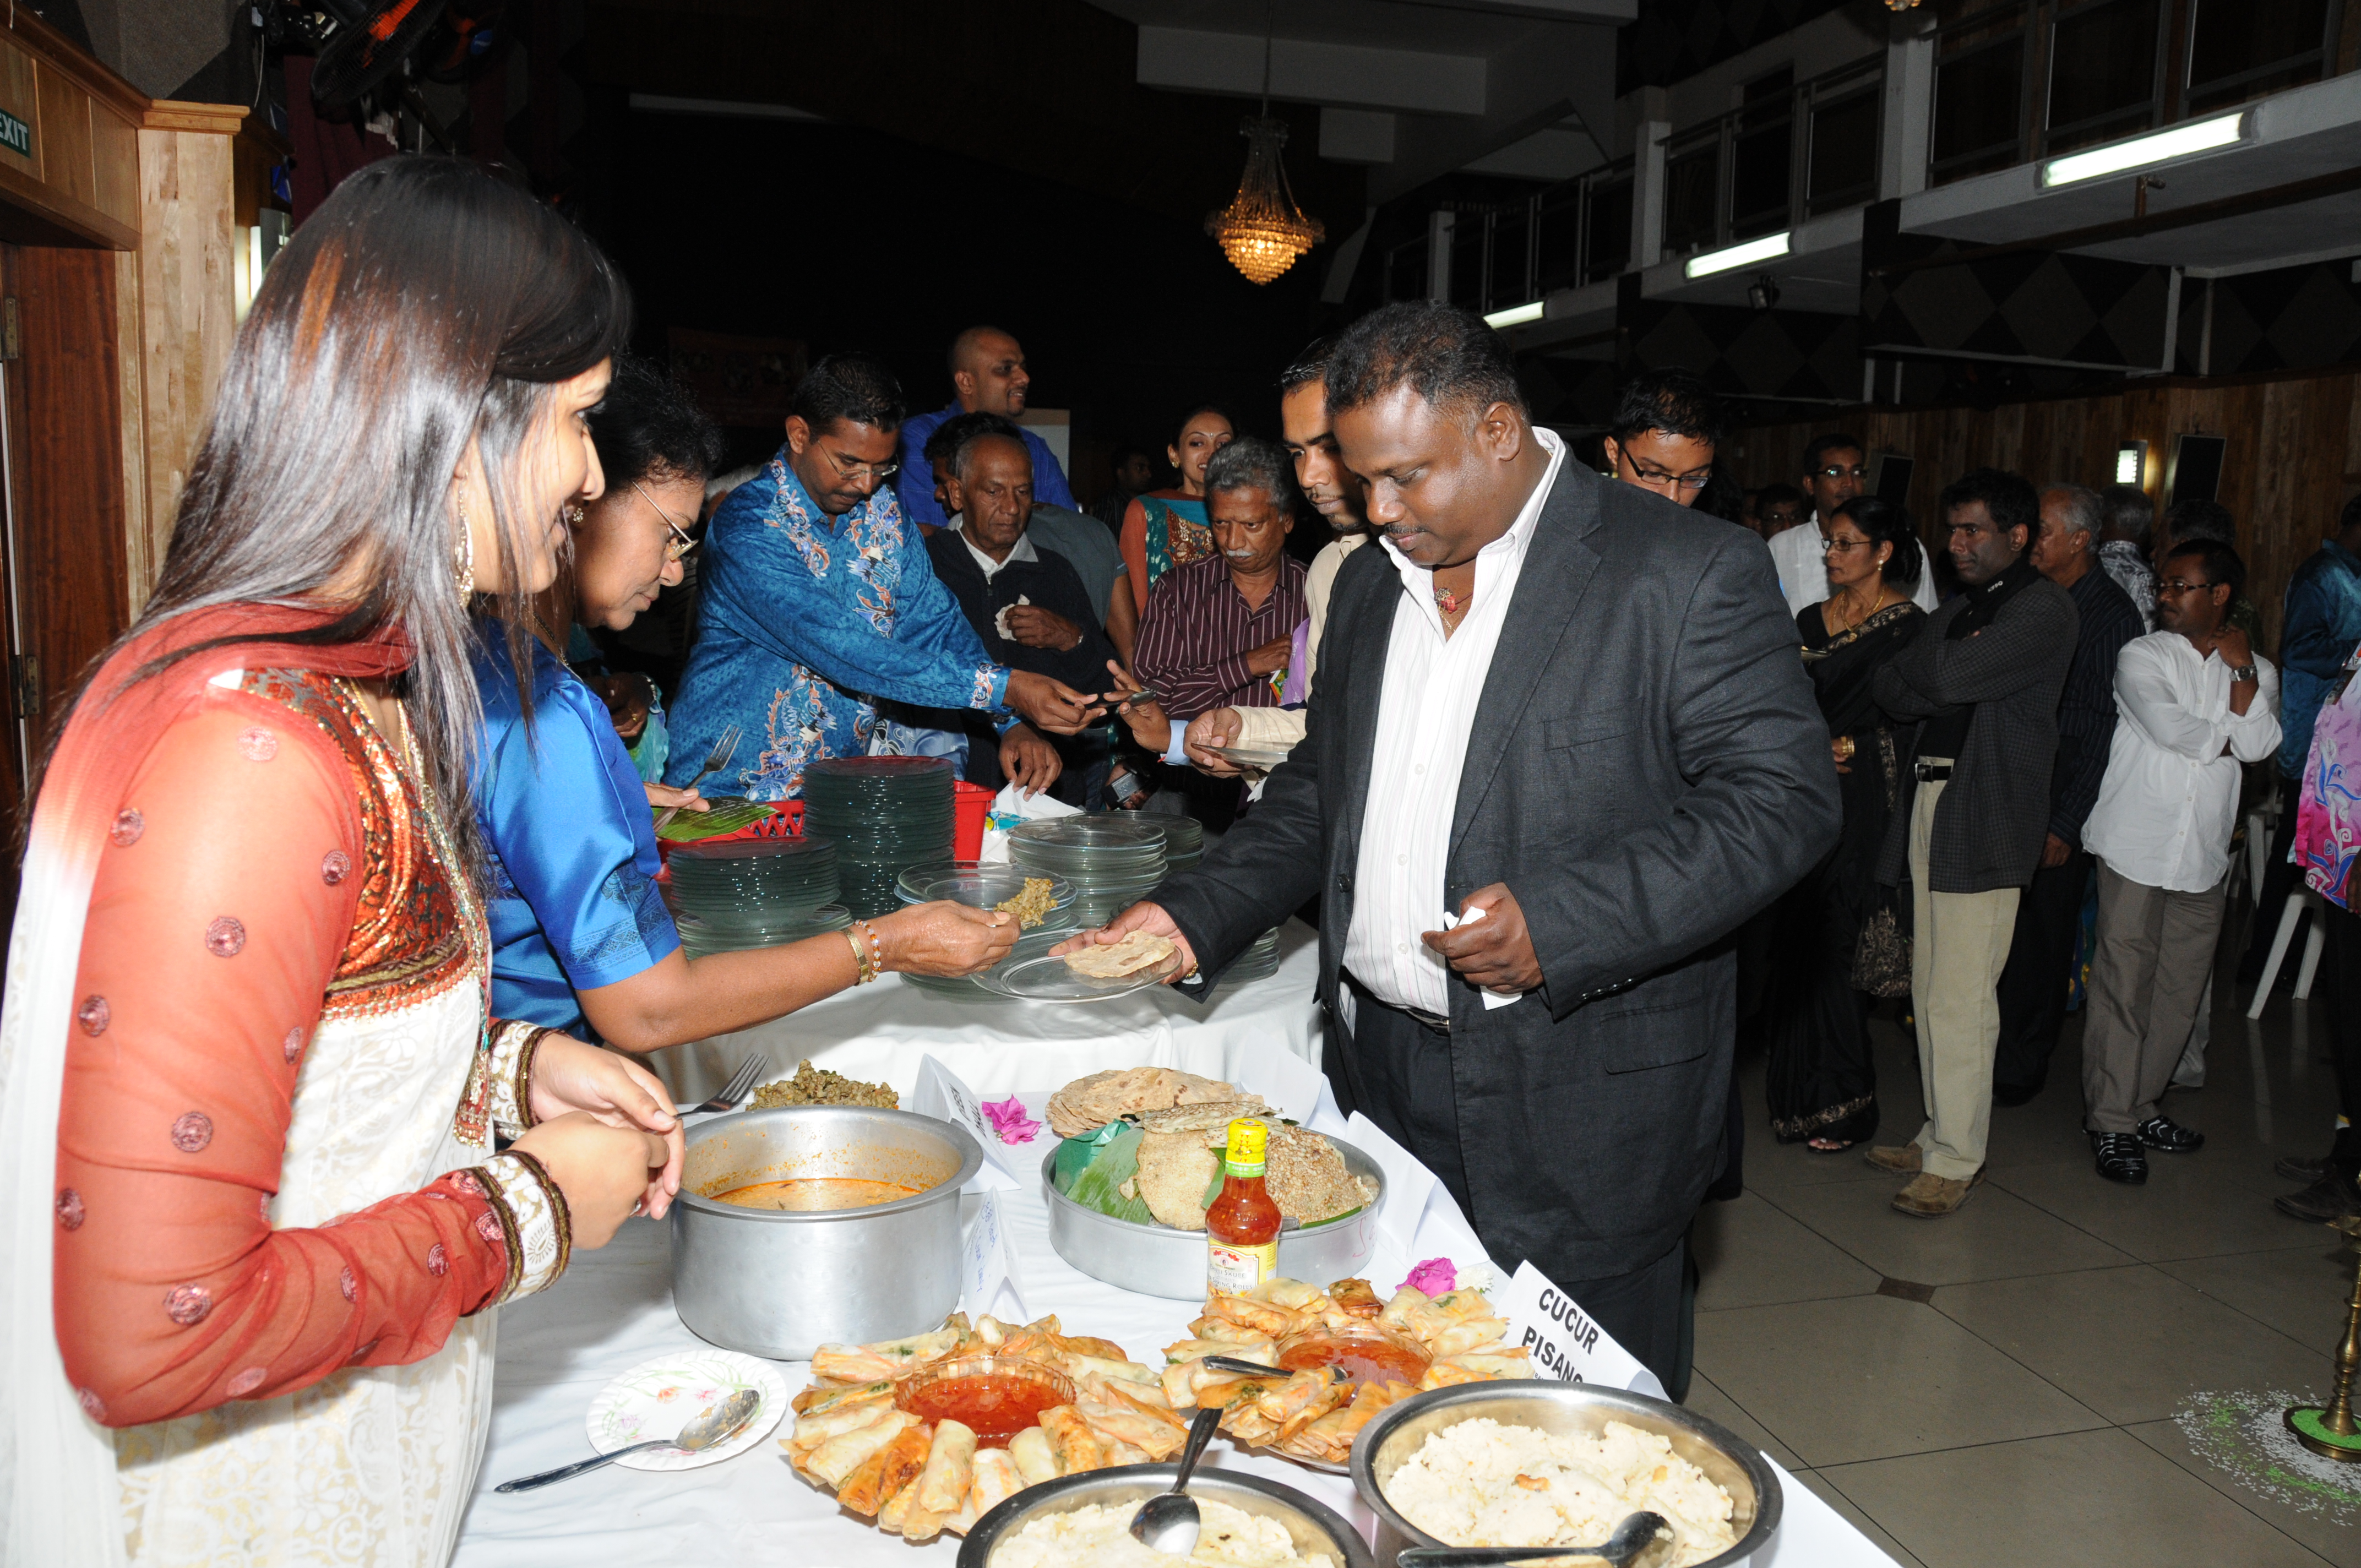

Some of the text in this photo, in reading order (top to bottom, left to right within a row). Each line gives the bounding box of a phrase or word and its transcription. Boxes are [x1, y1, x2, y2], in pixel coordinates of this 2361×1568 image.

[1225, 1270, 1245, 1278] SAUCE
[1212, 1277, 1231, 1288] SPRING
[1539, 1288, 1599, 1355] CUCUR
